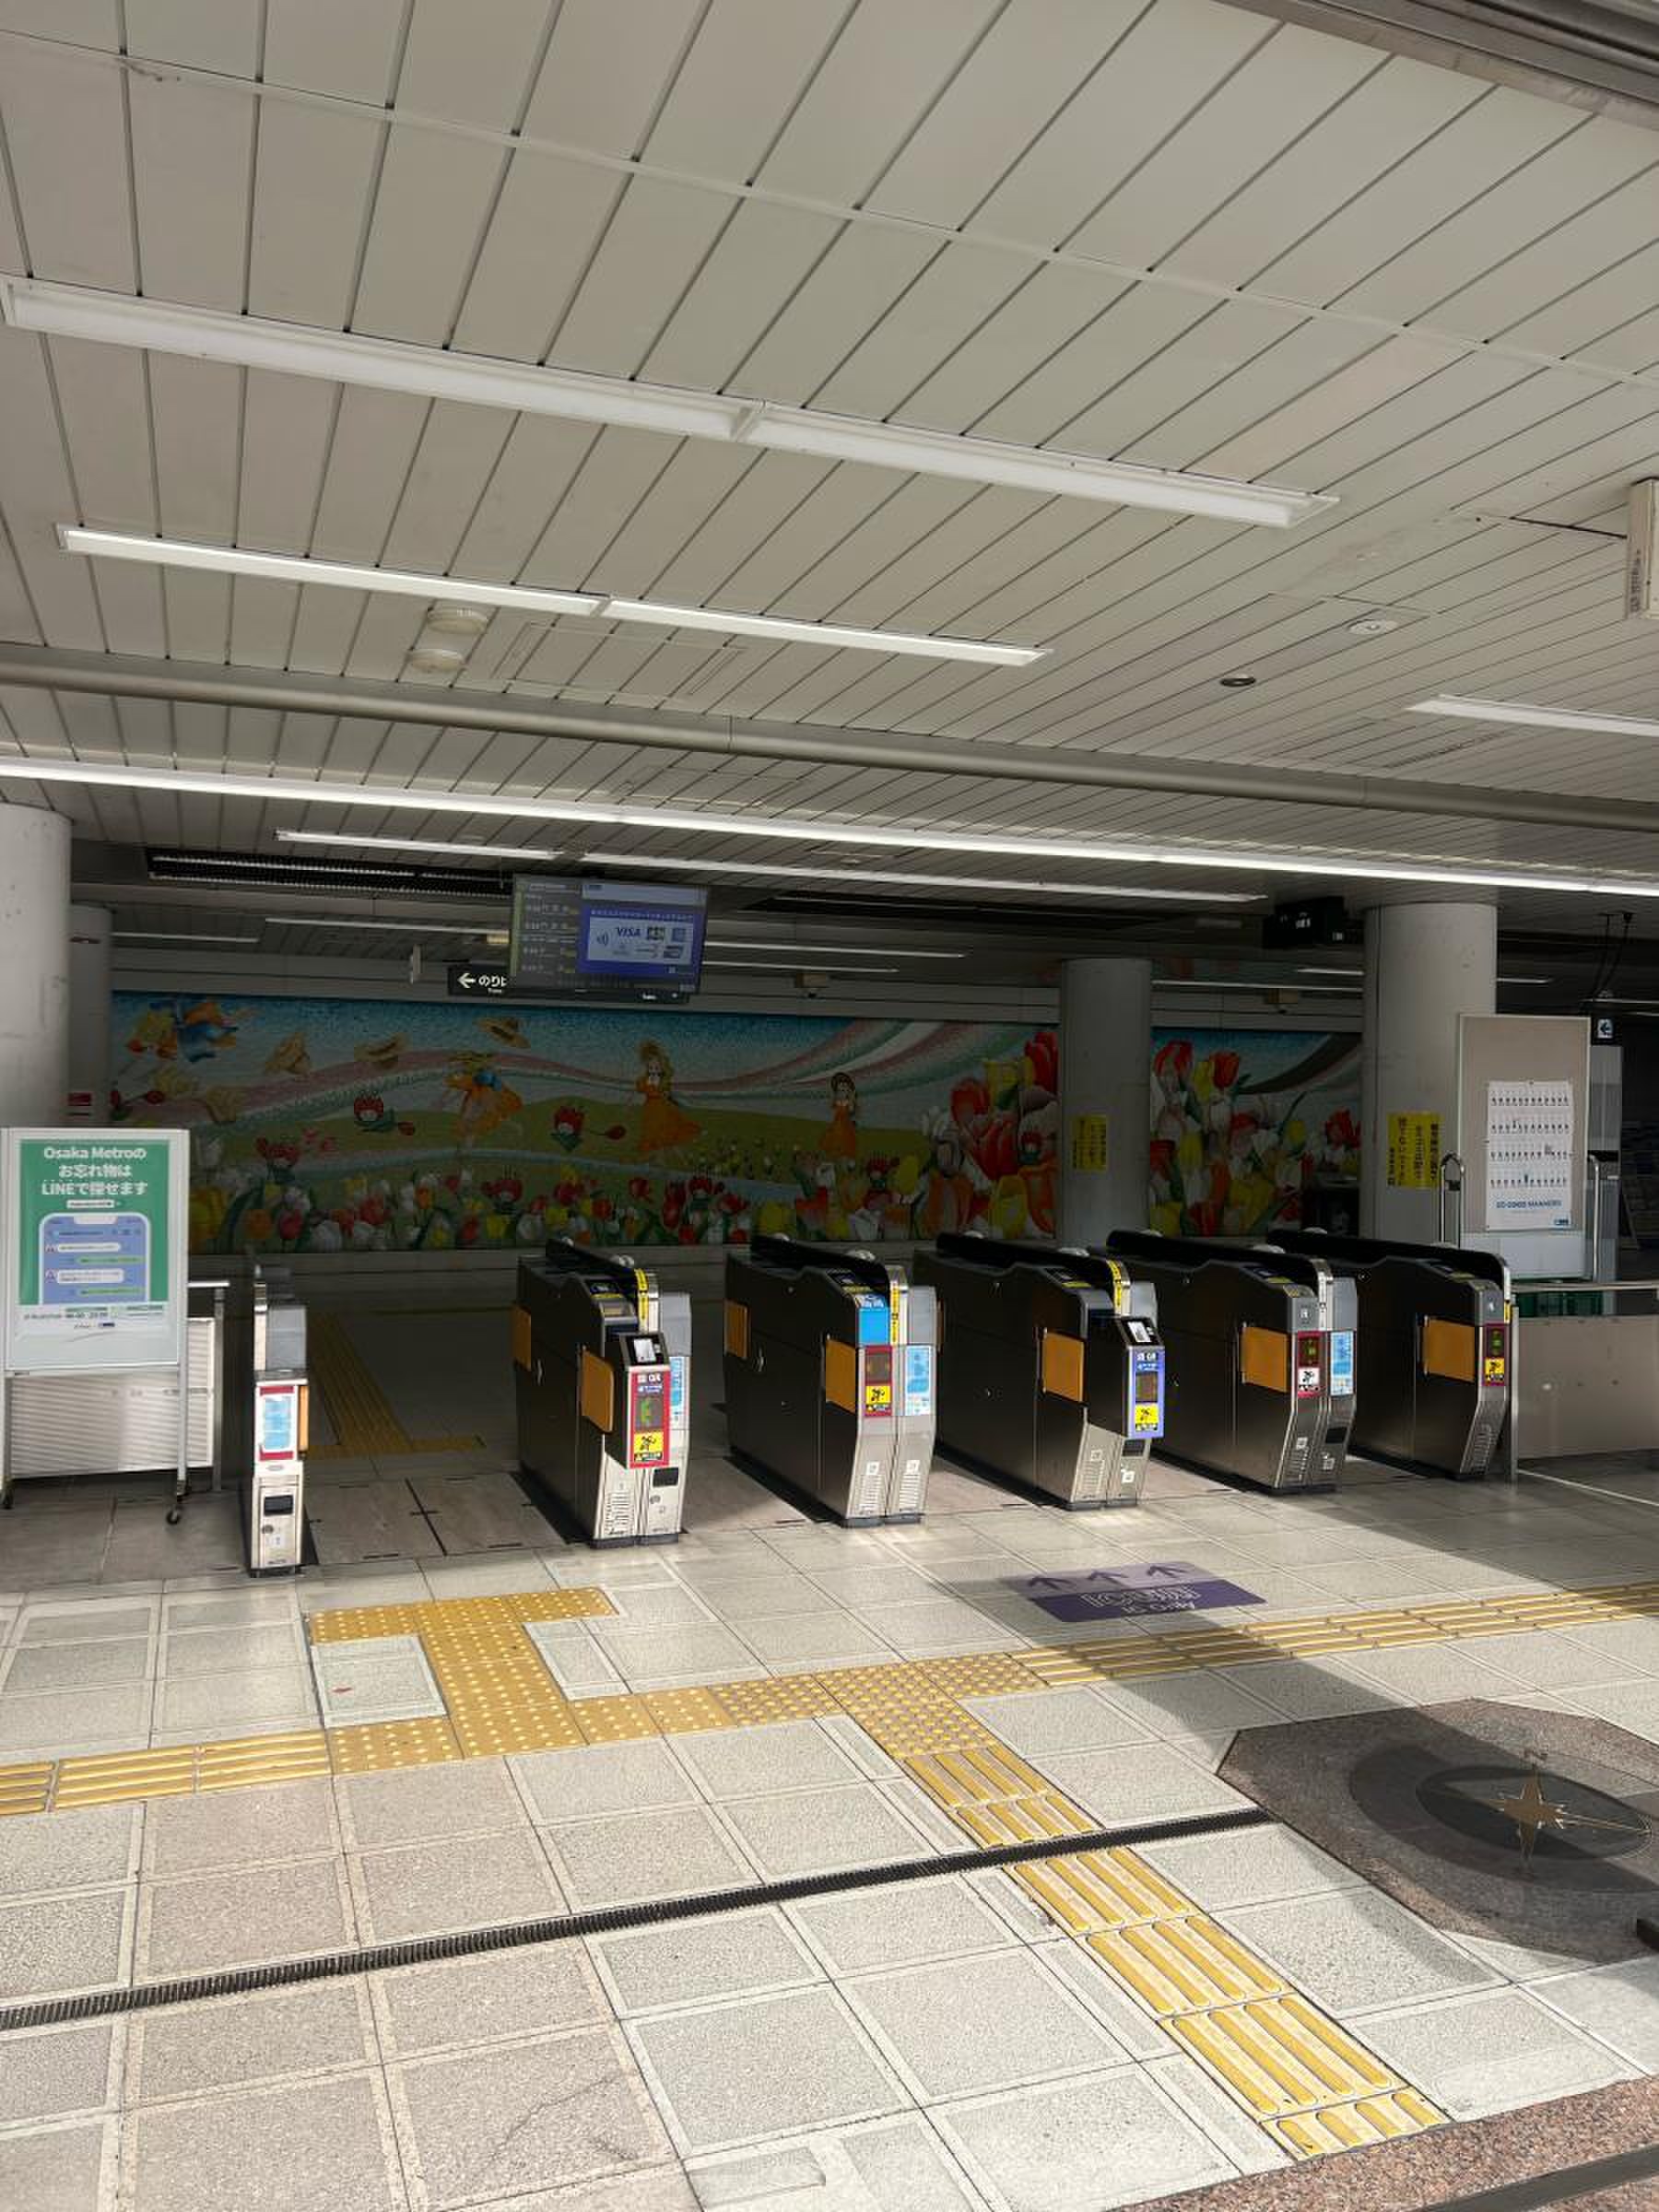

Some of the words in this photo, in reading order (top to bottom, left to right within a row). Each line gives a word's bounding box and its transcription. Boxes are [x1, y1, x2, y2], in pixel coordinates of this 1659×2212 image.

[615, 927, 641, 937] VISA
[43, 1147, 89, 1159] Osaka
[91, 1147, 147, 1159] Metroの
[58, 1163, 132, 1179] お忘れ物は
[41, 1181, 147, 1195] LINEで探せます
